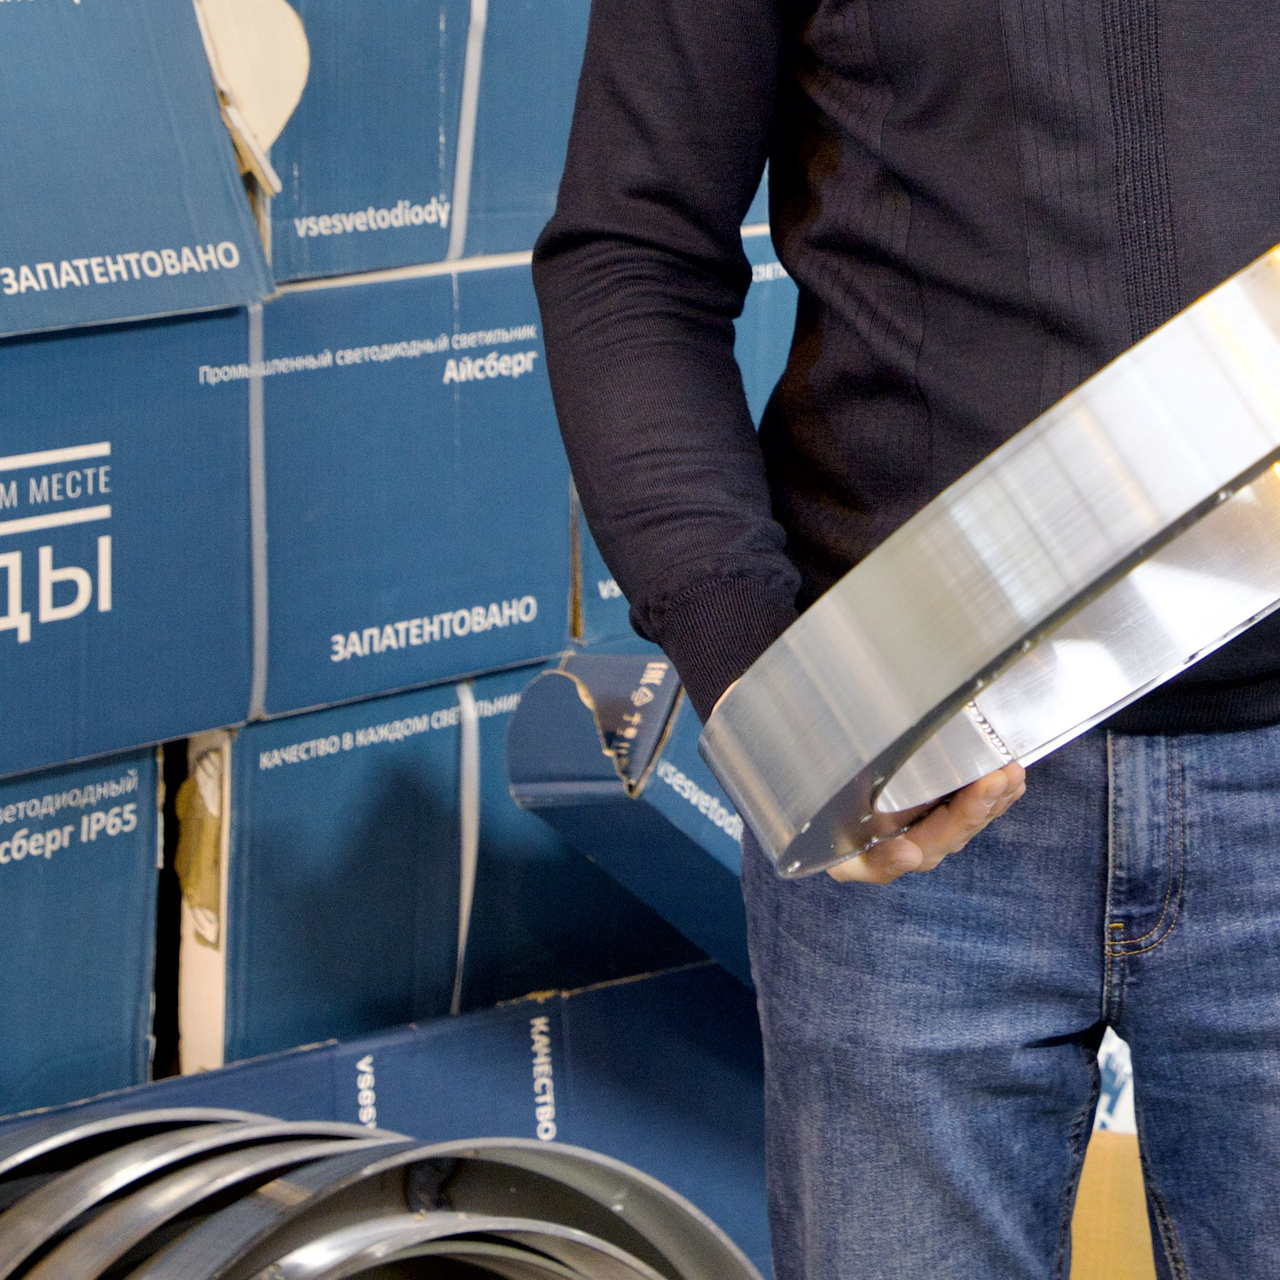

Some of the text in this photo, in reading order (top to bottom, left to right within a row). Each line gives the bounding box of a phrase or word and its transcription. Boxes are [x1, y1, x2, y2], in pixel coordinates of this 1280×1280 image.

[293, 195, 451, 238] vsesvetodiody
[1, 240, 240, 296] ЗАПАТЕНТОВАНО
[335, 333, 449, 367] светодиодный
[451, 323, 537, 350] светильник
[443, 350, 538, 384] Айсберг
[29, 465, 112, 505] МЕСТЕ
[330, 595, 538, 662] ЗАПАТЕНТОВАНО
[259, 734, 341, 770] КАЧЕСТВО
[342, 731, 354, 750] В
[355, 714, 430, 747] КАЖДОМ
[0, 768, 139, 825] етодиодный
[80, 802, 138, 843] IP65
[529, 1015, 557, 1141] КАЧЕСТВО
